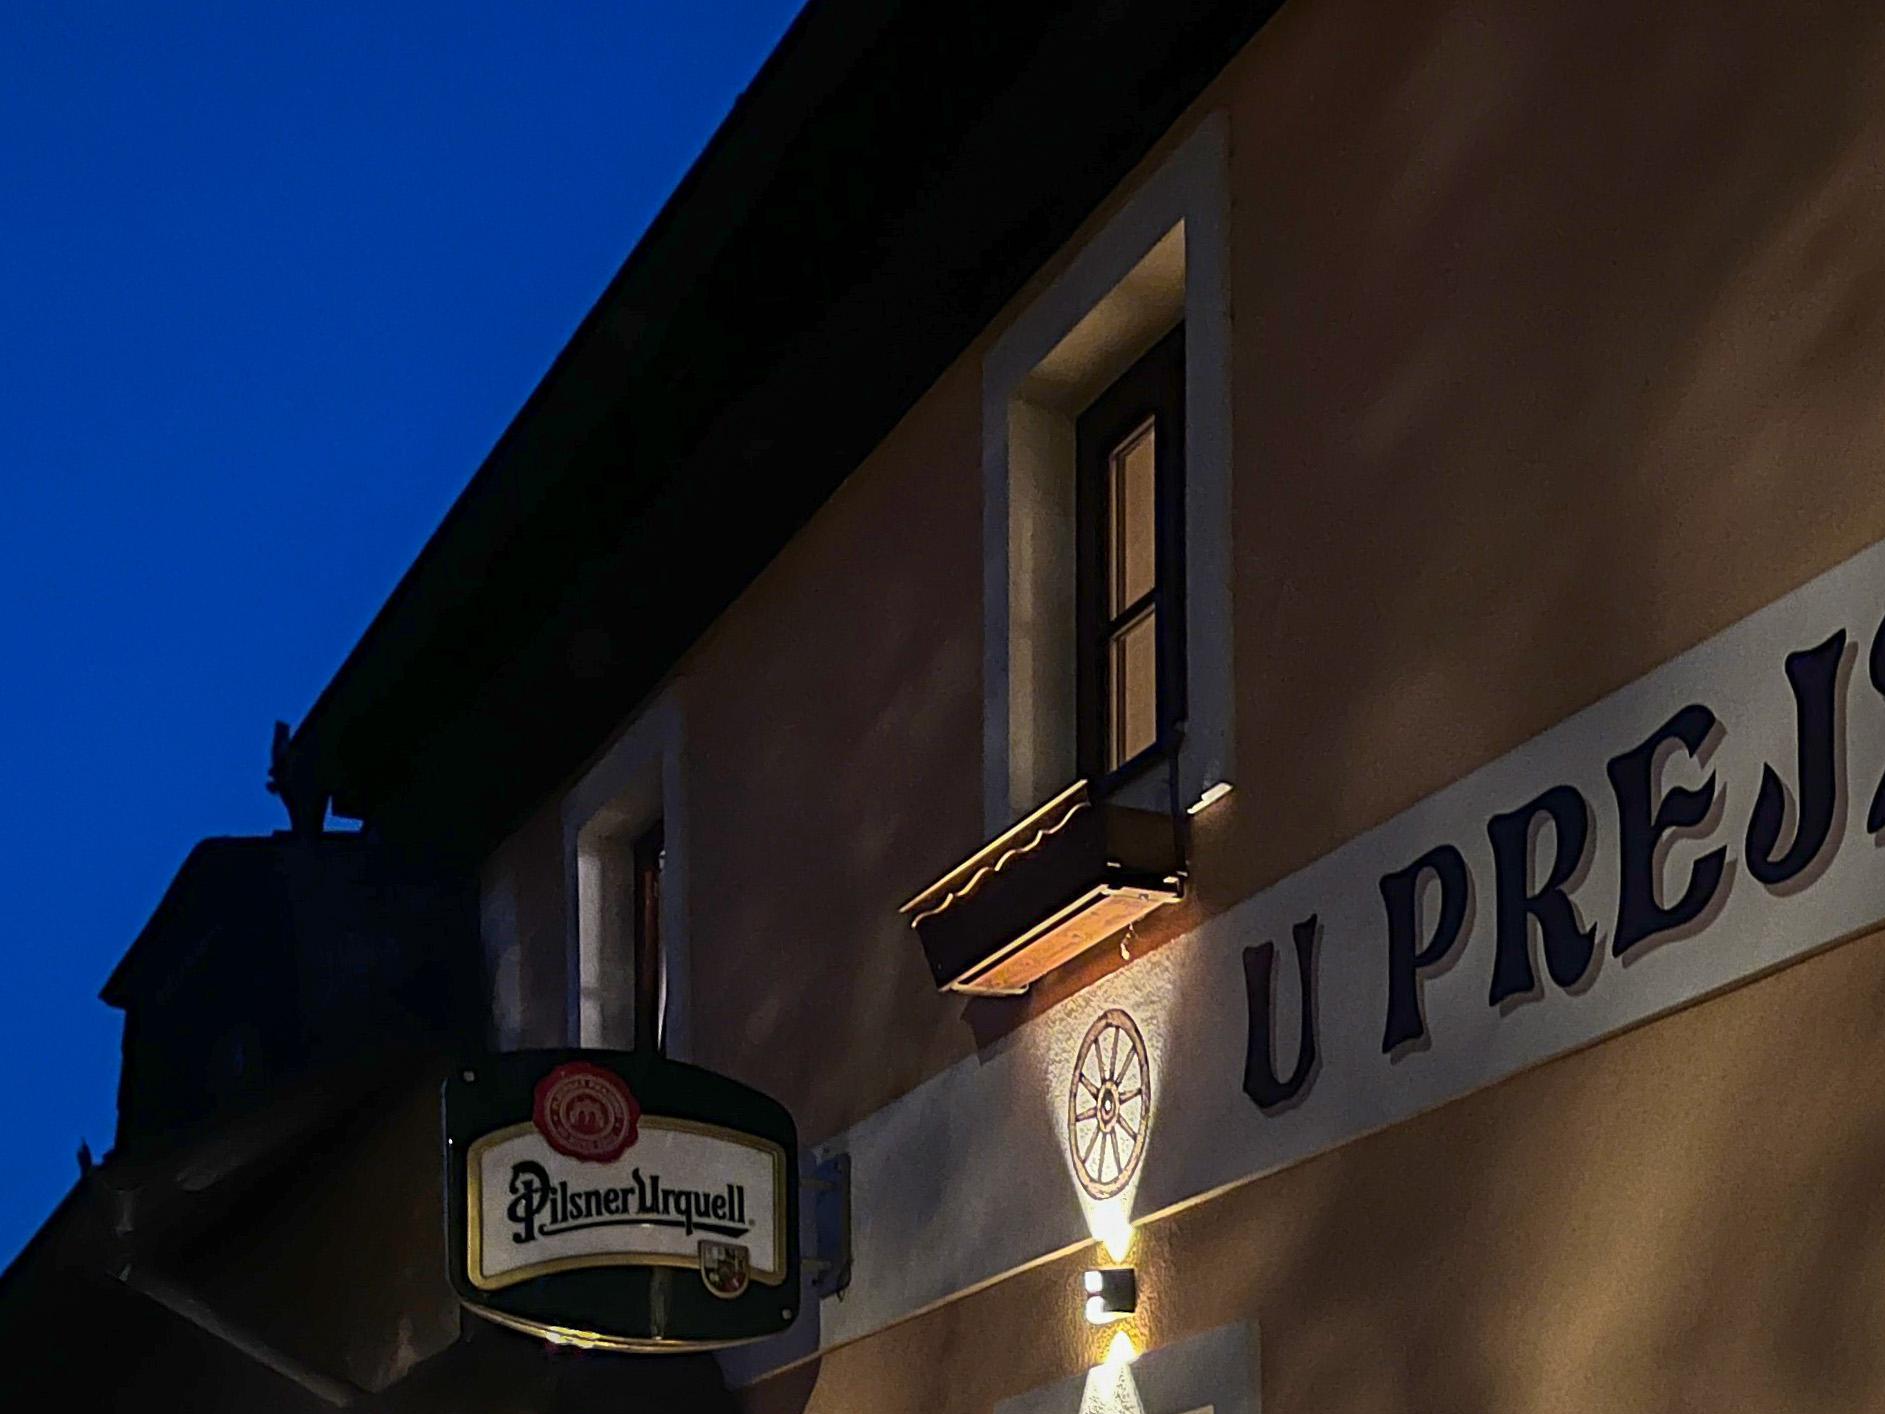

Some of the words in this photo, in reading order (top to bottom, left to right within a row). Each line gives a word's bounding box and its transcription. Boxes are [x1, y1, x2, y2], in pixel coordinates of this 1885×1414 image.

[1242, 912, 1321, 1114] U
[507, 1160, 636, 1243] Pilsner
[632, 1168, 746, 1236] Urquell
